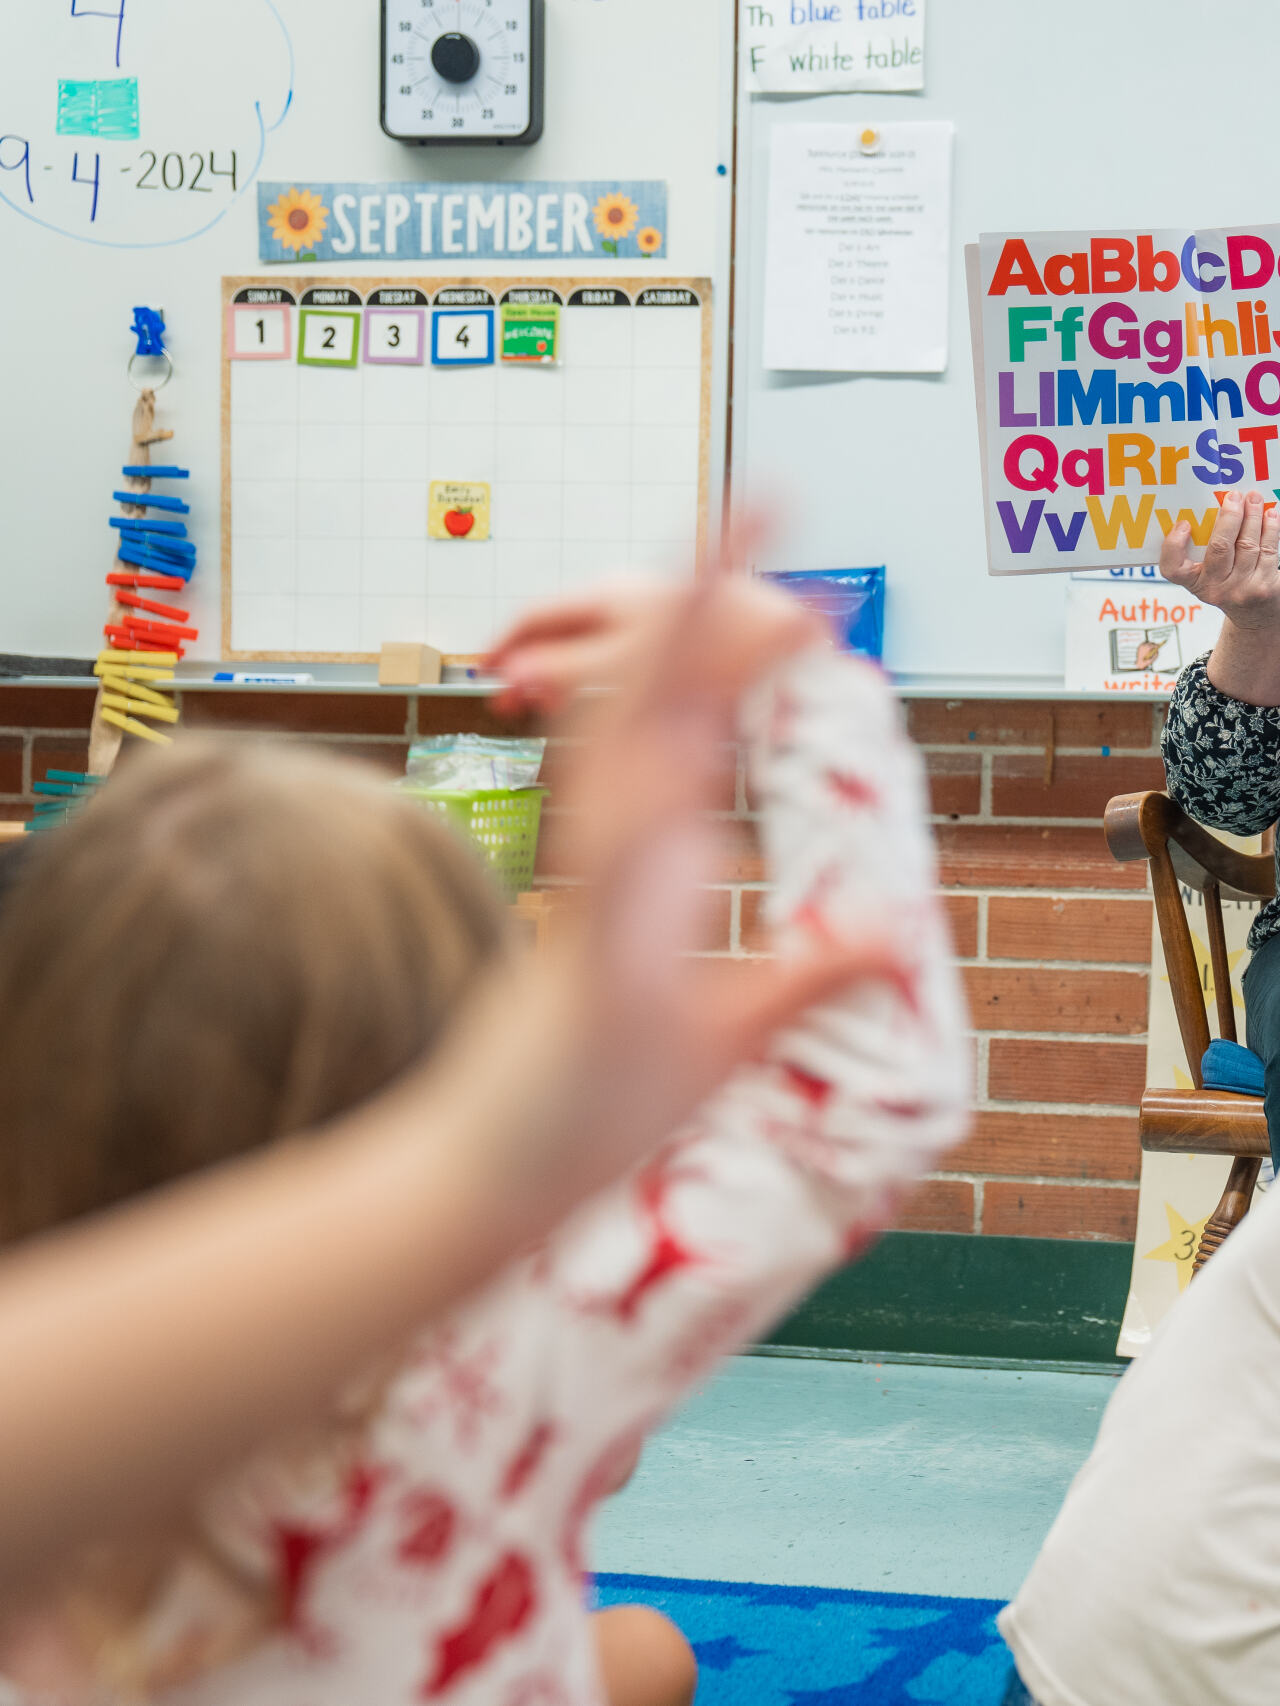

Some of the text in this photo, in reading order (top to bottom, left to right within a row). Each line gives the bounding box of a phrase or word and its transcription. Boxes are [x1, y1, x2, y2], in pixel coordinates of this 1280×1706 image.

[747, 0, 917, 27] Th blue table
[71, 0, 124, 67] 4
[392, 54, 404, 64] 45
[750, 36, 922, 72] F white table
[399, 85, 412, 95] 40
[331, 192, 594, 254] SEPTEMBER
[256, 319, 264, 343] 1
[322, 326, 336, 348] 2
[387, 325, 400, 347] 3
[456, 324, 470, 348] 4
[1098, 597, 1202, 624] Author
